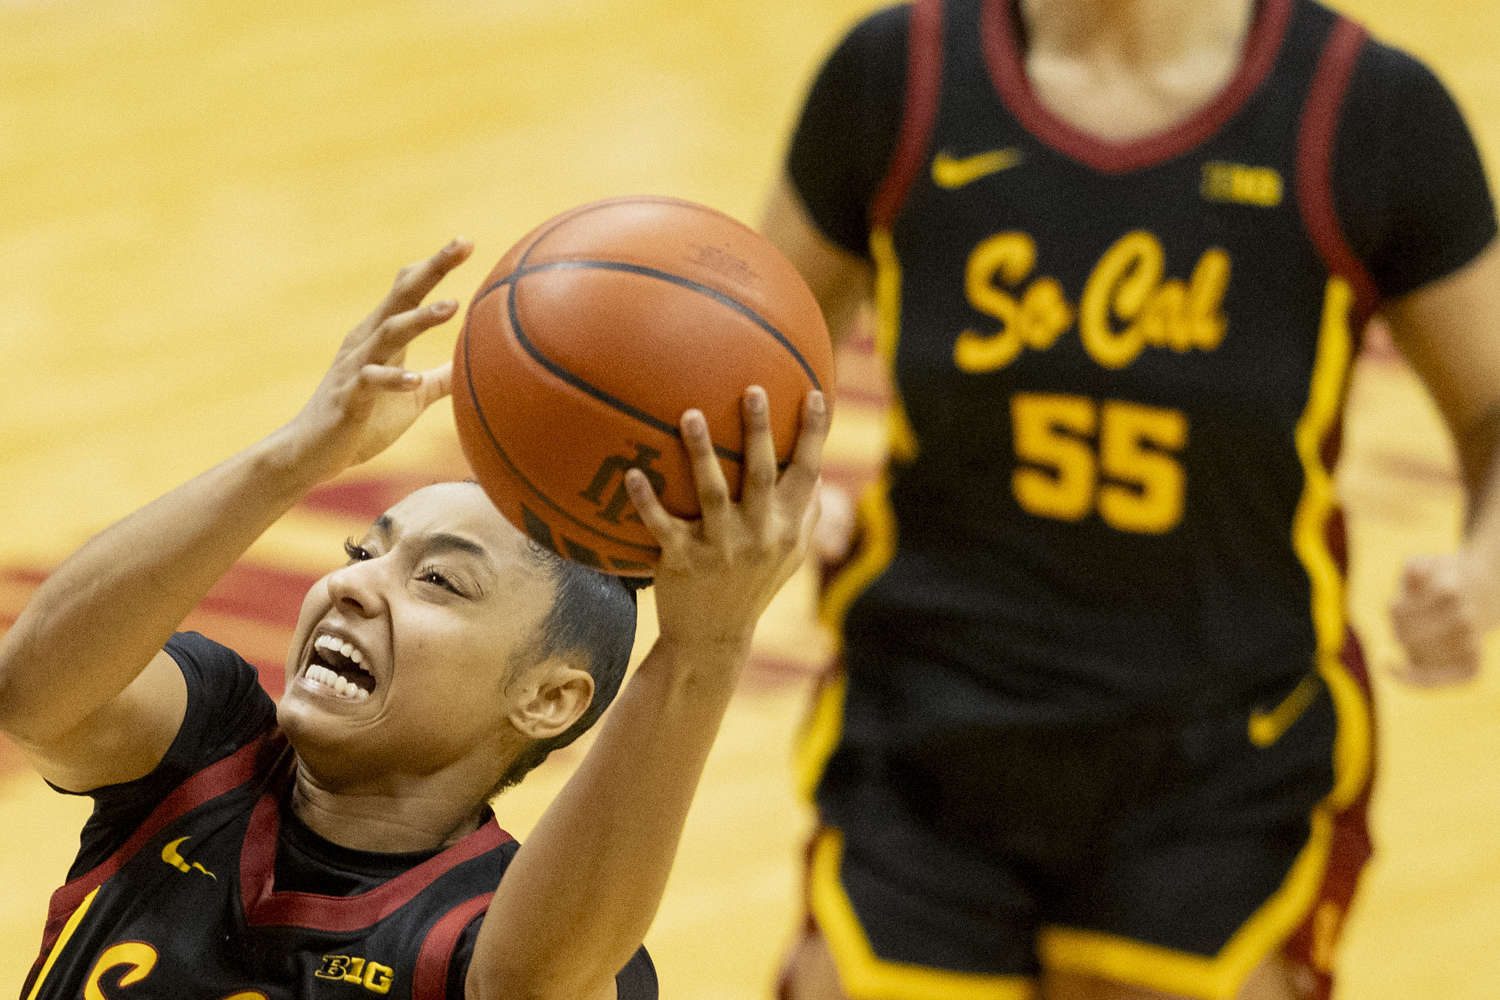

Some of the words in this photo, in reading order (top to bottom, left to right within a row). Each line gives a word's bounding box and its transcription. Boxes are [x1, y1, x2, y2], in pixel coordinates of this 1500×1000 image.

[953, 230, 1075, 374] So
[1078, 228, 1232, 370] Cal
[1009, 391, 1190, 535] 55
